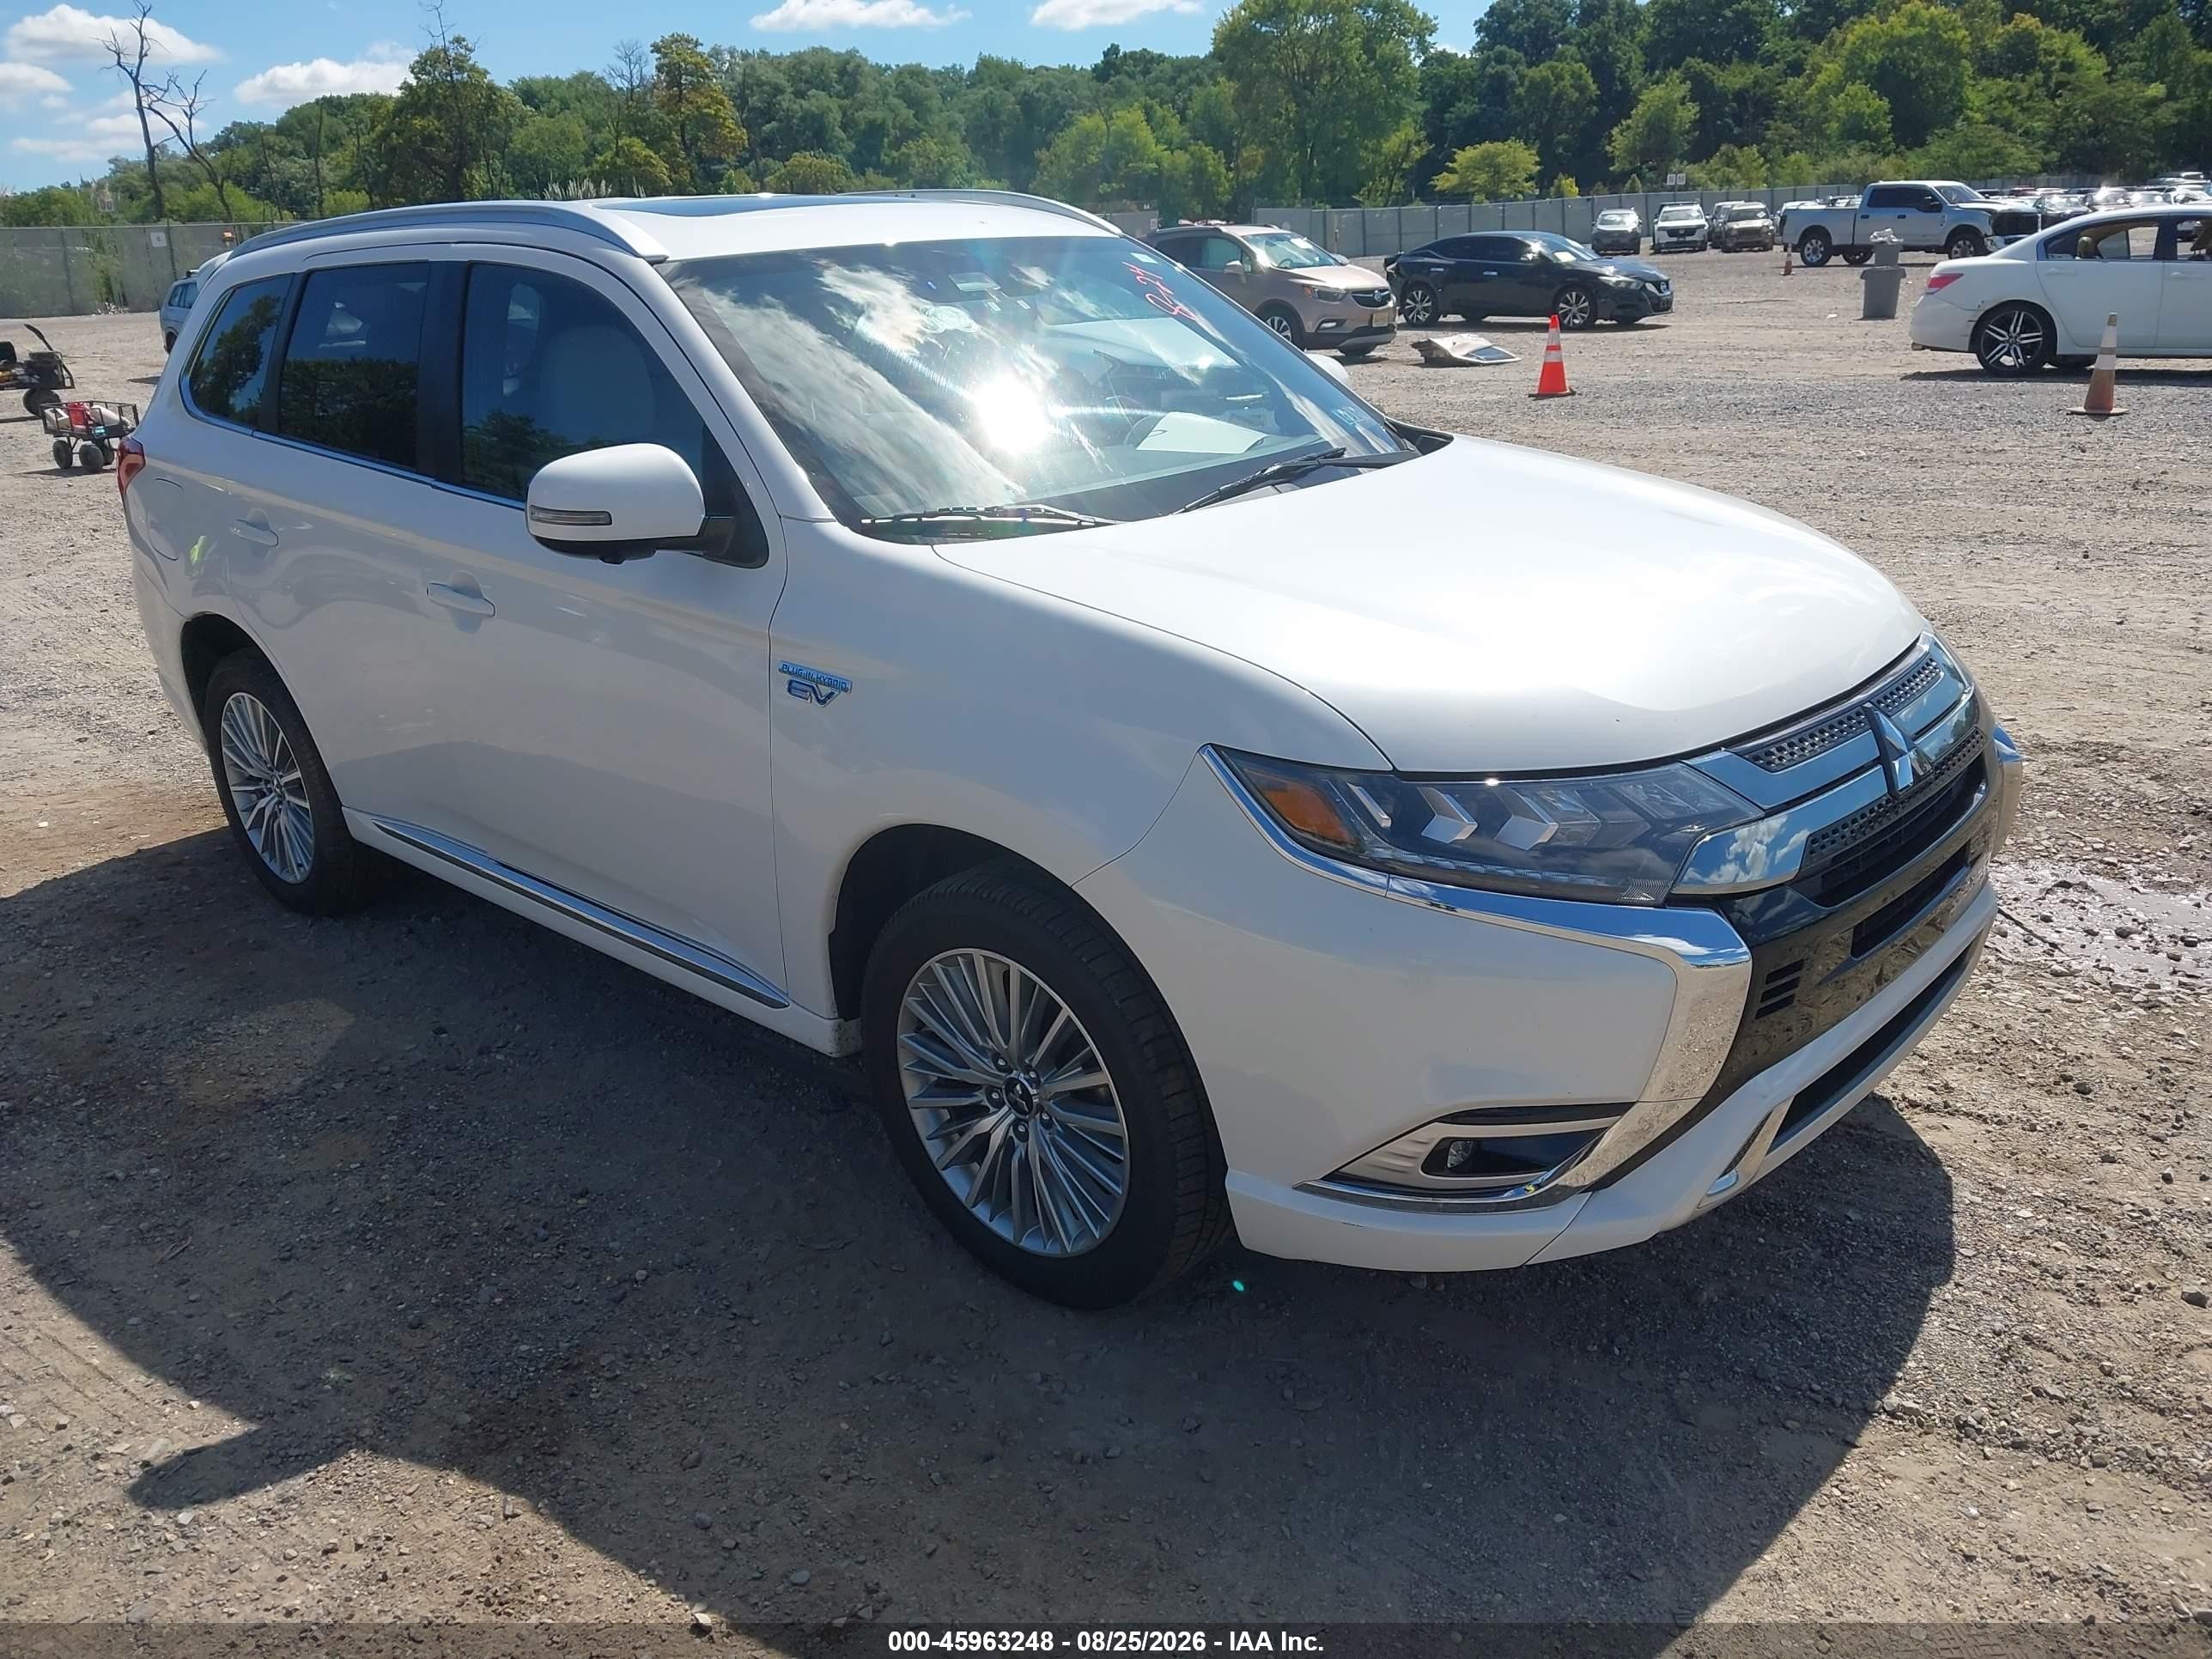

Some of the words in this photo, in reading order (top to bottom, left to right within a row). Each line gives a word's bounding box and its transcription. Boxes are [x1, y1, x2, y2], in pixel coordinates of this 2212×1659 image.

[781, 663, 816, 680] PLUG-IN
[817, 672, 848, 692] HYBRID
[787, 678, 841, 707] EV
